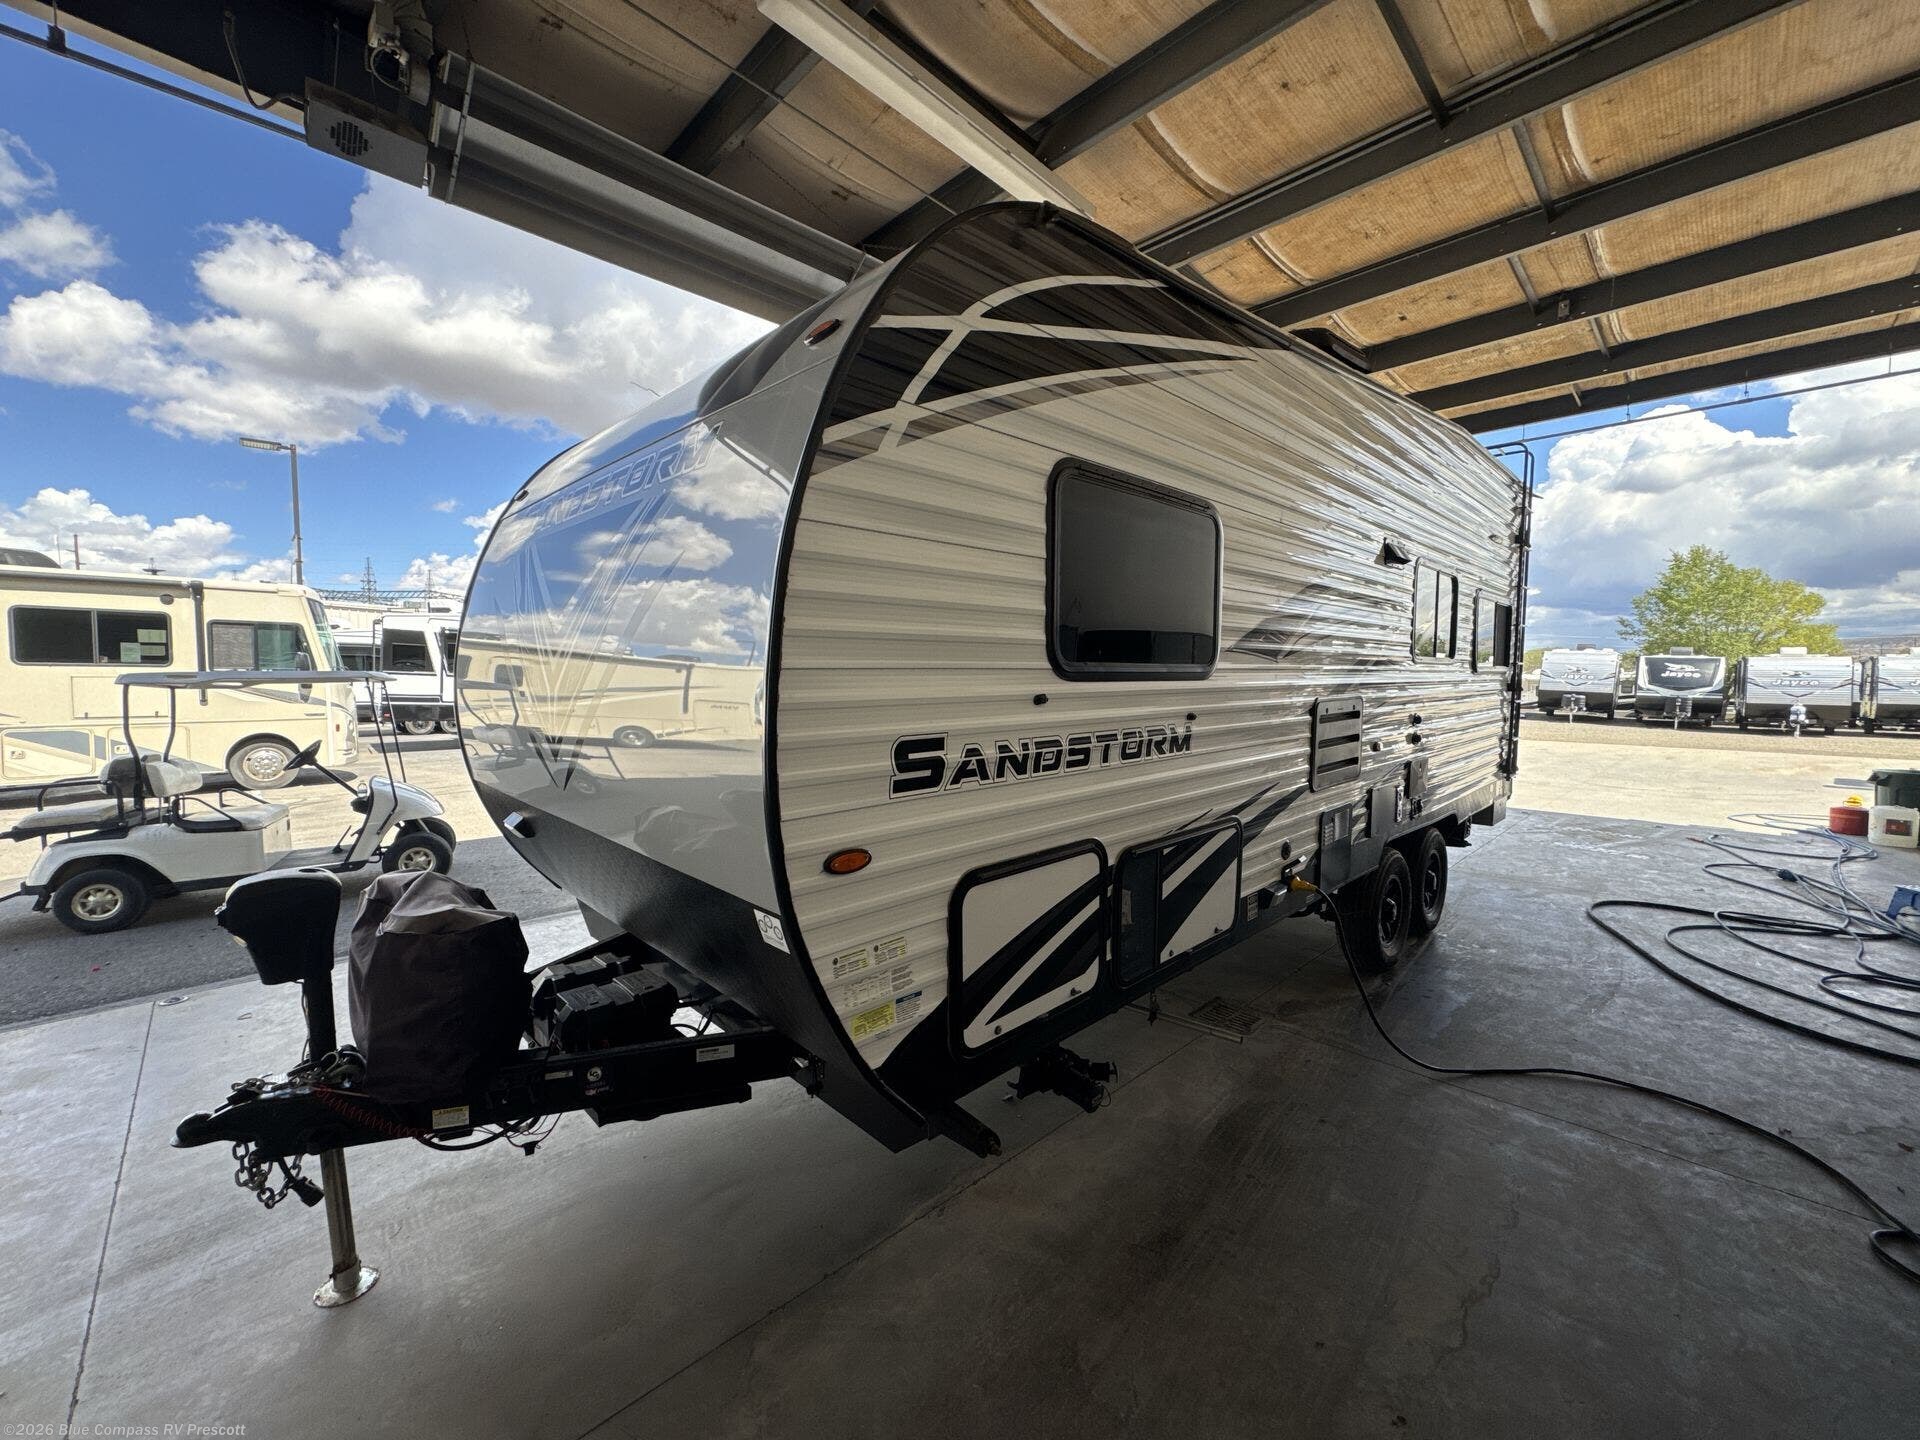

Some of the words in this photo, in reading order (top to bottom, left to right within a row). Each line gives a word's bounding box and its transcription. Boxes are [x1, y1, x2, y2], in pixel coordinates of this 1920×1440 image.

[1560, 672, 1594, 681] Jayco
[1660, 670, 1702, 679] Jayco
[1772, 678, 1820, 687] Jayco
[889, 723, 1193, 799] SANDSTORM
